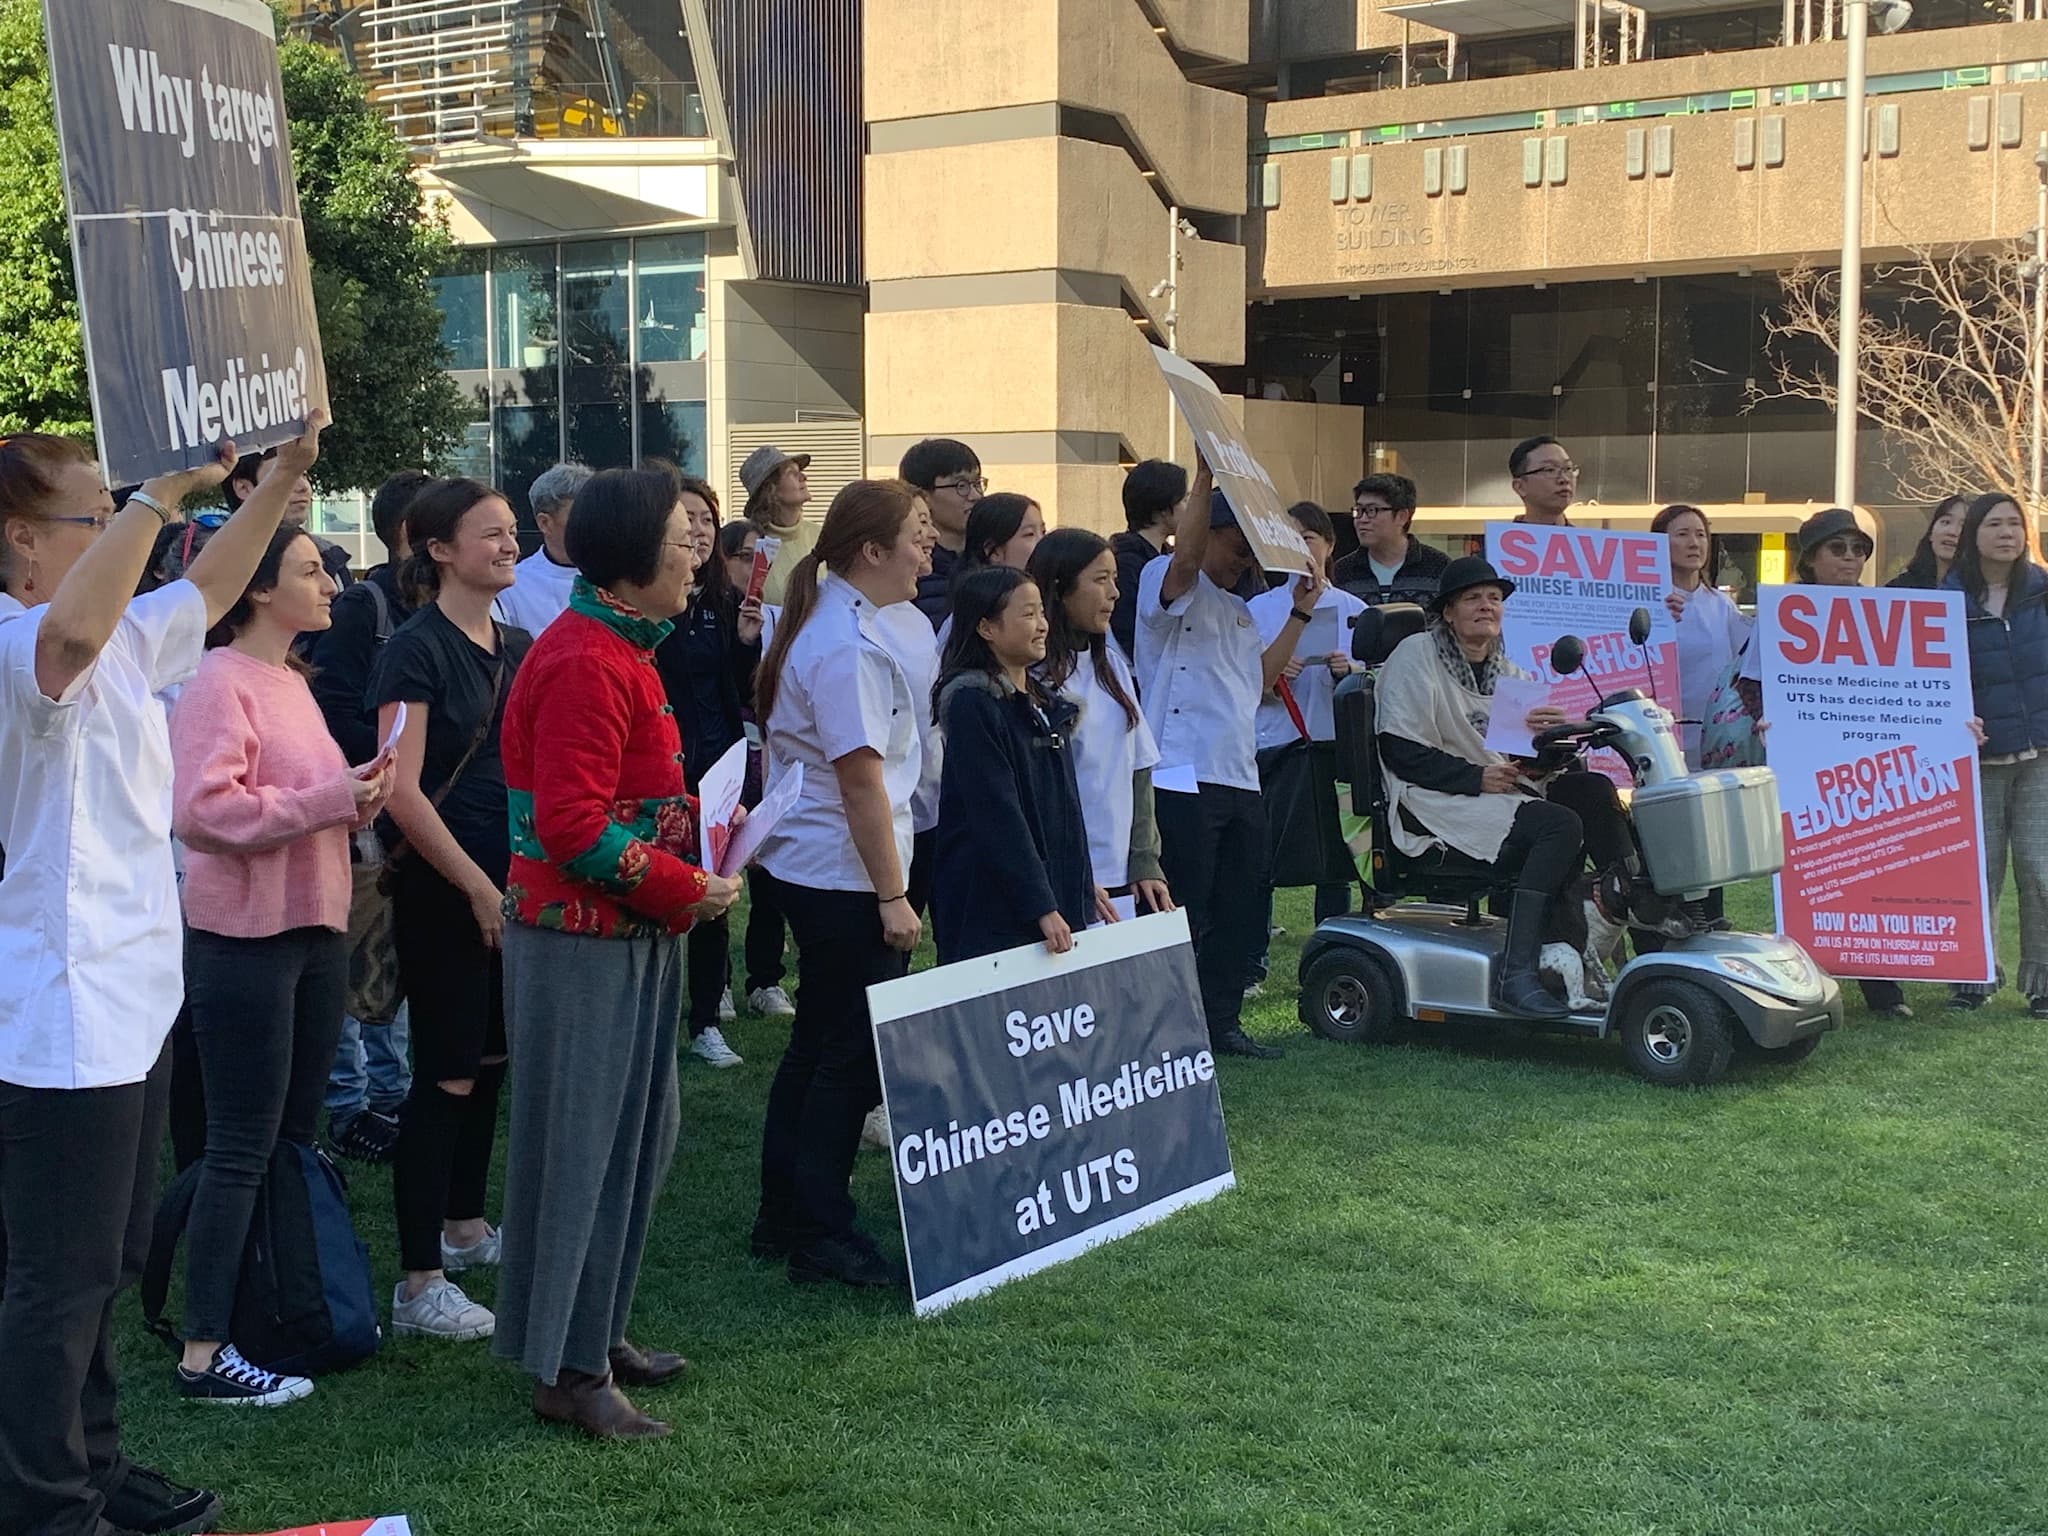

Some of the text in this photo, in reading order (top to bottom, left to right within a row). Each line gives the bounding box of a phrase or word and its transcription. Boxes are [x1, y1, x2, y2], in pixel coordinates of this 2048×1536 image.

[108, 43, 279, 165] Why target
[1337, 202, 1412, 226] TOWER
[168, 208, 284, 291] Chinese
[1336, 226, 1434, 251] BUILDING
[161, 346, 308, 452] Medicine?
[1500, 530, 1661, 585] SAVE
[1578, 581, 1662, 602] MEDICINE
[1777, 594, 1952, 669] SAVE
[1532, 632, 1626, 668] PFIT
[1777, 673, 1951, 690] Chinese Medicine at UTS
[1786, 692, 1951, 708] UTS has decided to axe
[1797, 710, 1942, 725] its Chinese Medicine
[1842, 730, 1901, 742] program
[1815, 744, 1917, 802] PROFIT
[1790, 763, 1961, 840] EDUCATION
[1871, 848, 1886, 859] UTS
[1823, 879, 1840, 890] UTS
[1812, 911, 1957, 936] HOW CAN YOU HELP?
[1813, 936, 1831, 947] JOIN
[1831, 936, 1842, 948] US
[1843, 937, 1852, 948] AT
[1870, 938, 1882, 949] ON
[1882, 938, 1921, 951] THURSDAY
[1921, 940, 1939, 951] JULY
[1839, 952, 1935, 966] AT THE UTS ALUMNI GREEN
[1005, 1003, 1096, 1058] Save
[898, 1050, 1215, 1185] Chinese Medicine
[1015, 1147, 1140, 1236] at UTS
